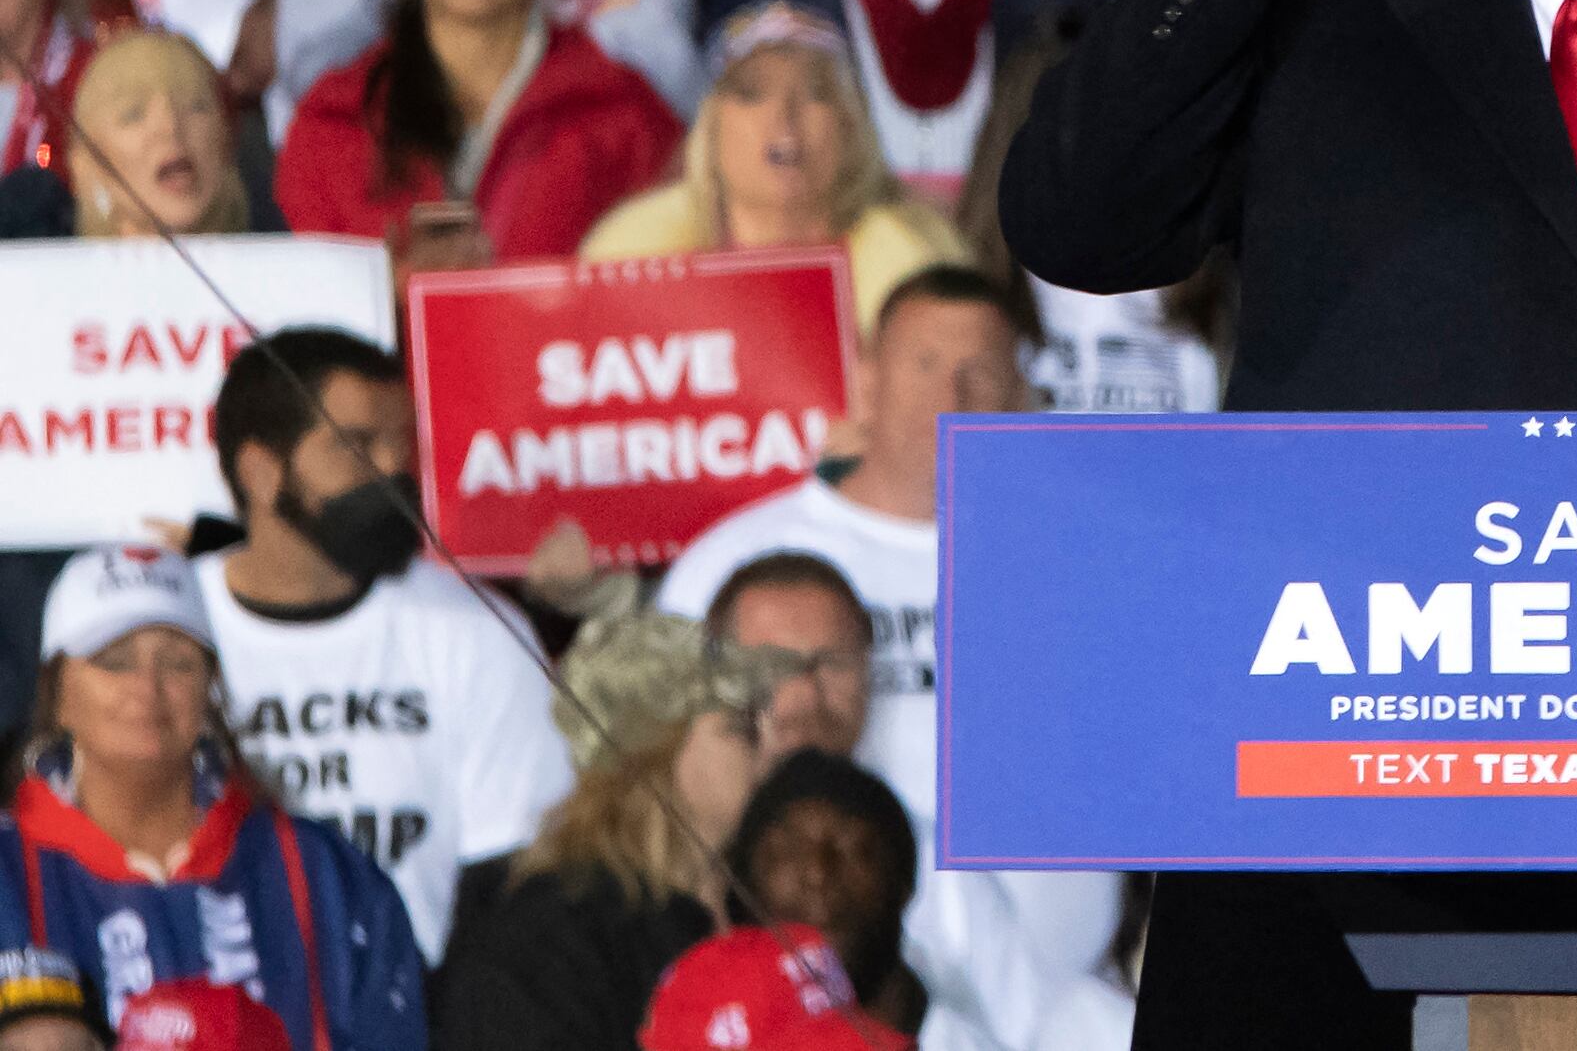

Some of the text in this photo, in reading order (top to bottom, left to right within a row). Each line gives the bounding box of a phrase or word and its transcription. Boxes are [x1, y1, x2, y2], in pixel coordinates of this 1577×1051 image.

[537, 330, 738, 407] SAVE
[1330, 695, 1527, 720] PRESIDENT
[1349, 753, 1459, 785] TEXT
